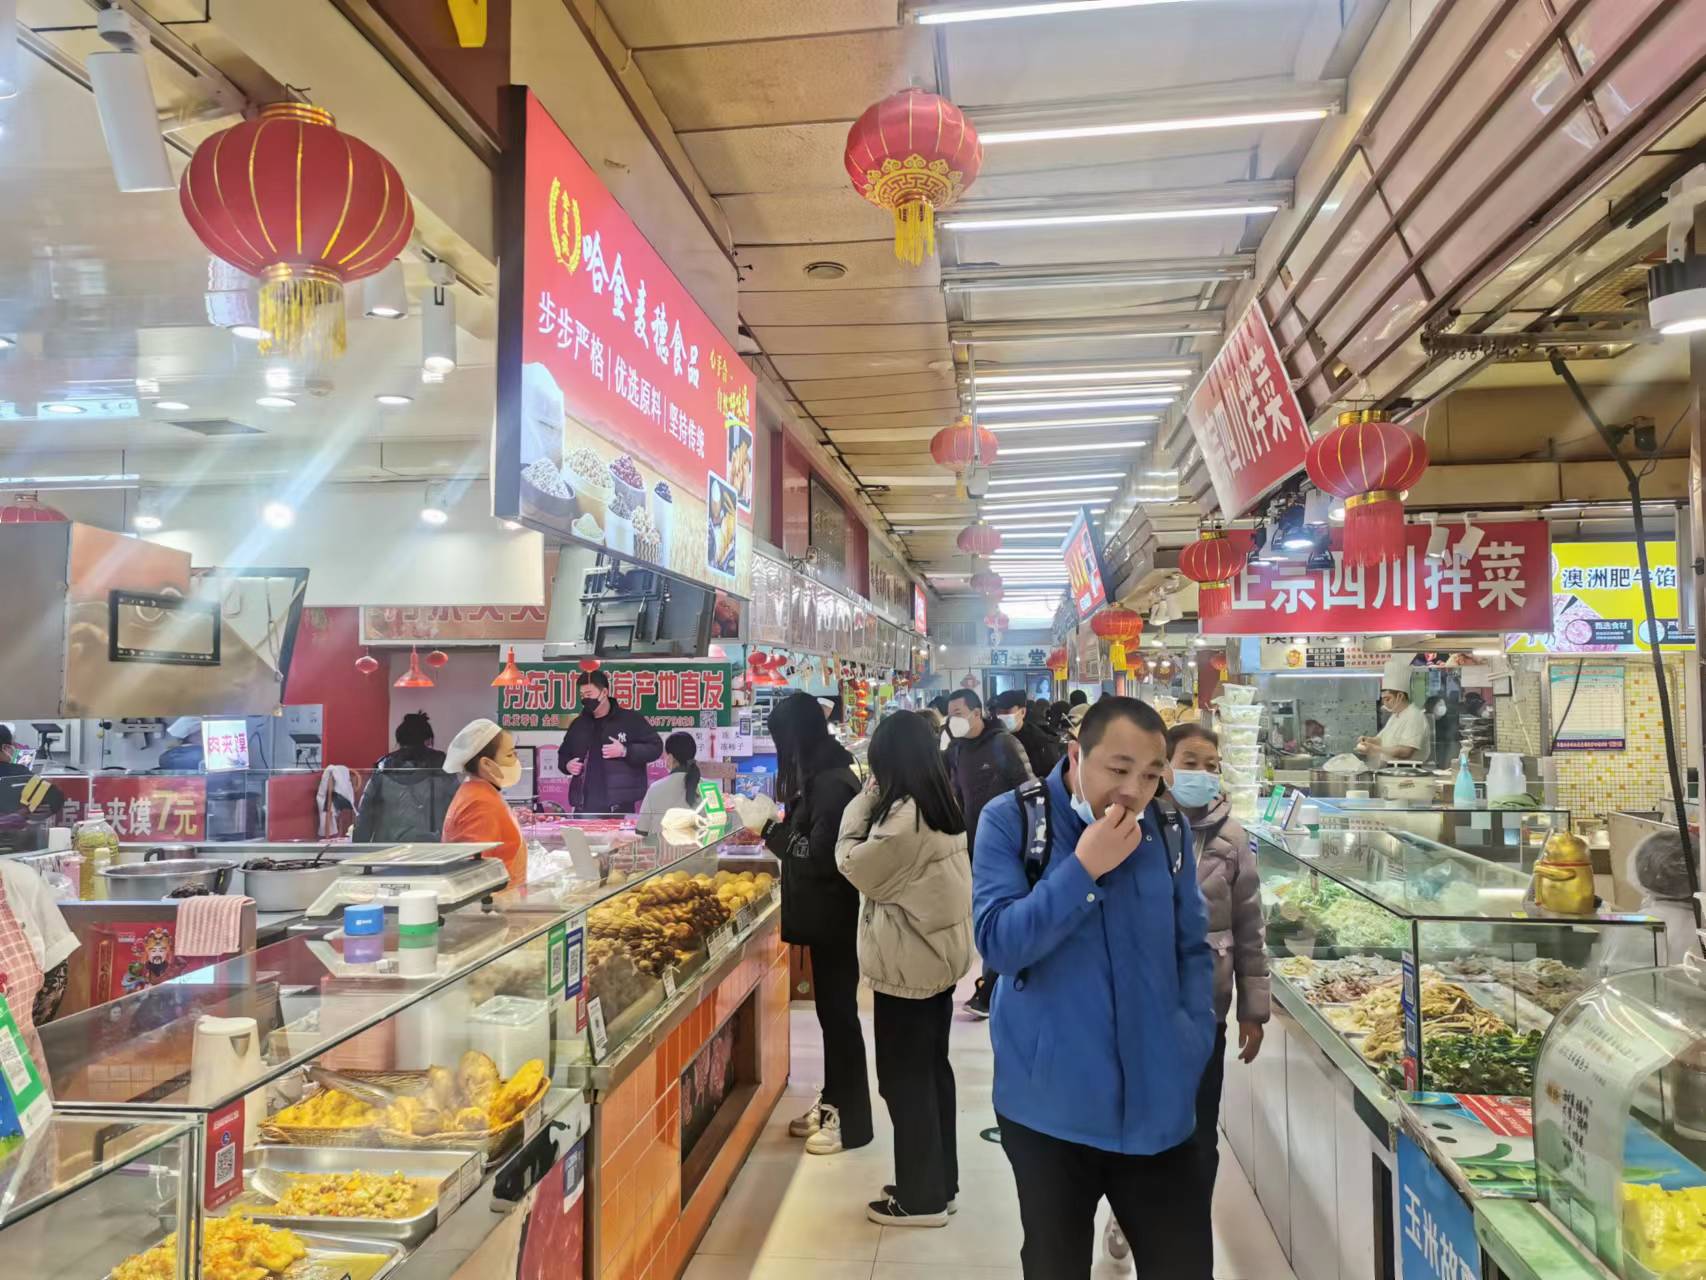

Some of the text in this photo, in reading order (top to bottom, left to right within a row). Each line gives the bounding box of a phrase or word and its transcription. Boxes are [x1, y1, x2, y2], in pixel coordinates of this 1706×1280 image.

[539, 291, 704, 458] 步步严格 优选原料 坚持传统
[1203, 345, 1292, 479] 宗四川拌菜
[1231, 541, 1527, 614] 正宗四川拌菜
